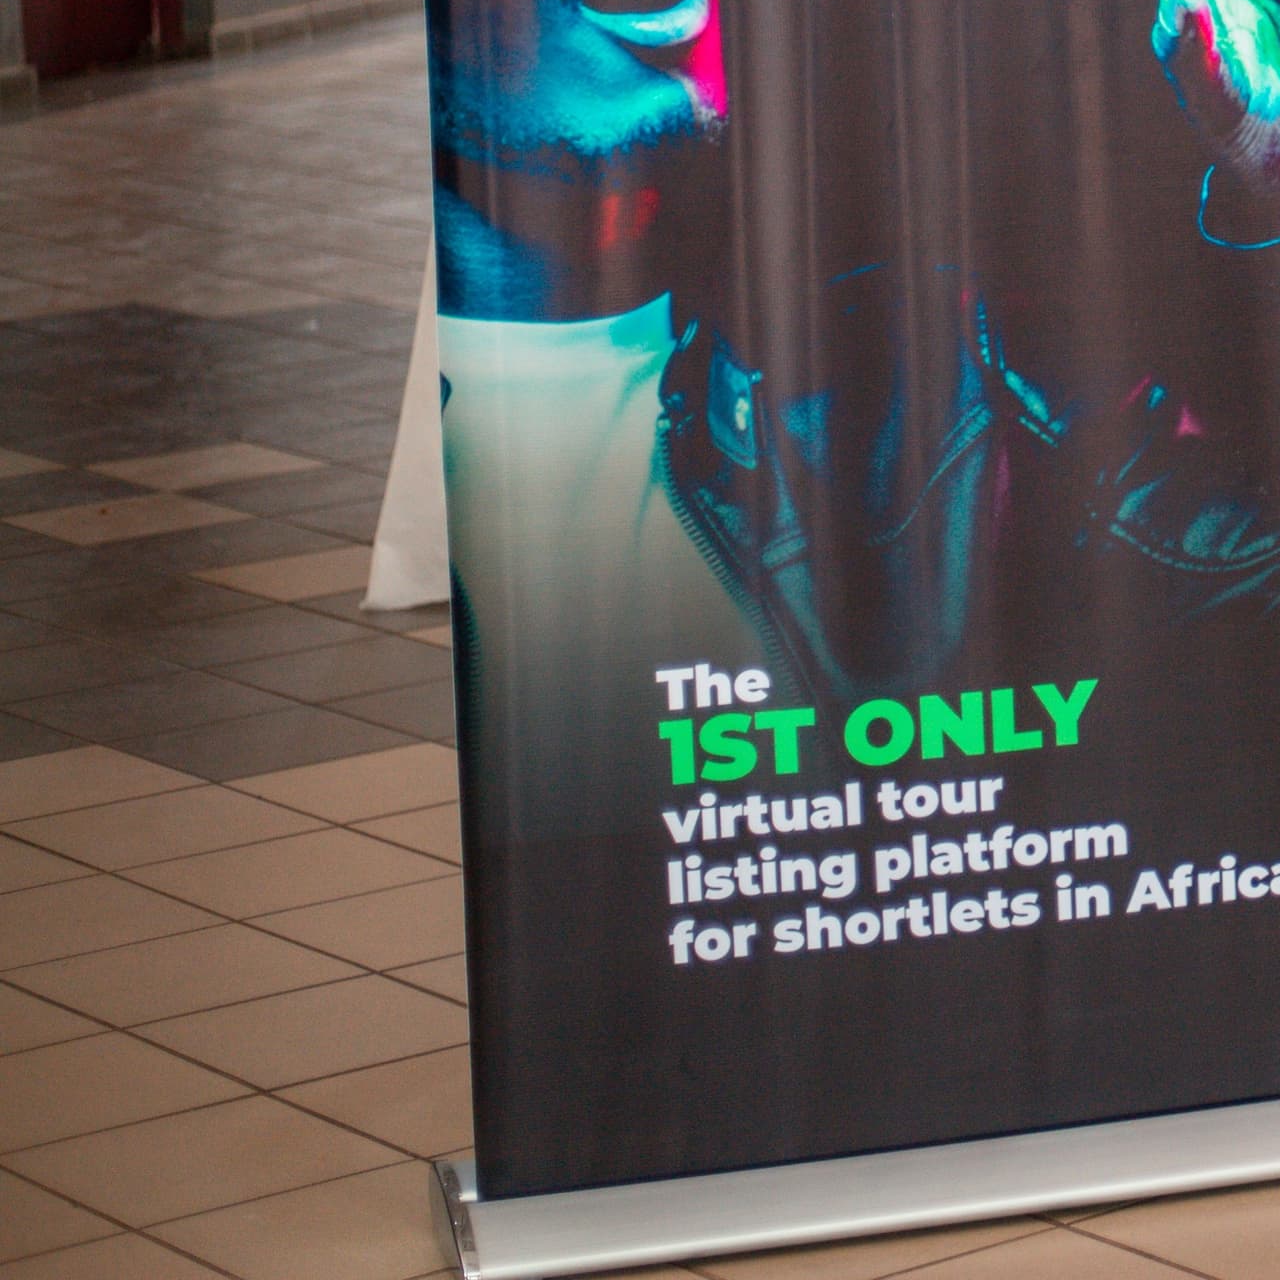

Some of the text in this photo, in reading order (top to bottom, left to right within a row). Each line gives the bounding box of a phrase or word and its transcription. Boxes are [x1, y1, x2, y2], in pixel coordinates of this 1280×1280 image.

[656, 663, 771, 711] The
[658, 678, 1099, 787] 1ST ONLY
[662, 772, 1005, 844] virtual tour
[666, 816, 1128, 906] listing platform
[667, 916, 758, 966] for
[772, 886, 1040, 954] shortlets
[1055, 874, 1111, 923] in
